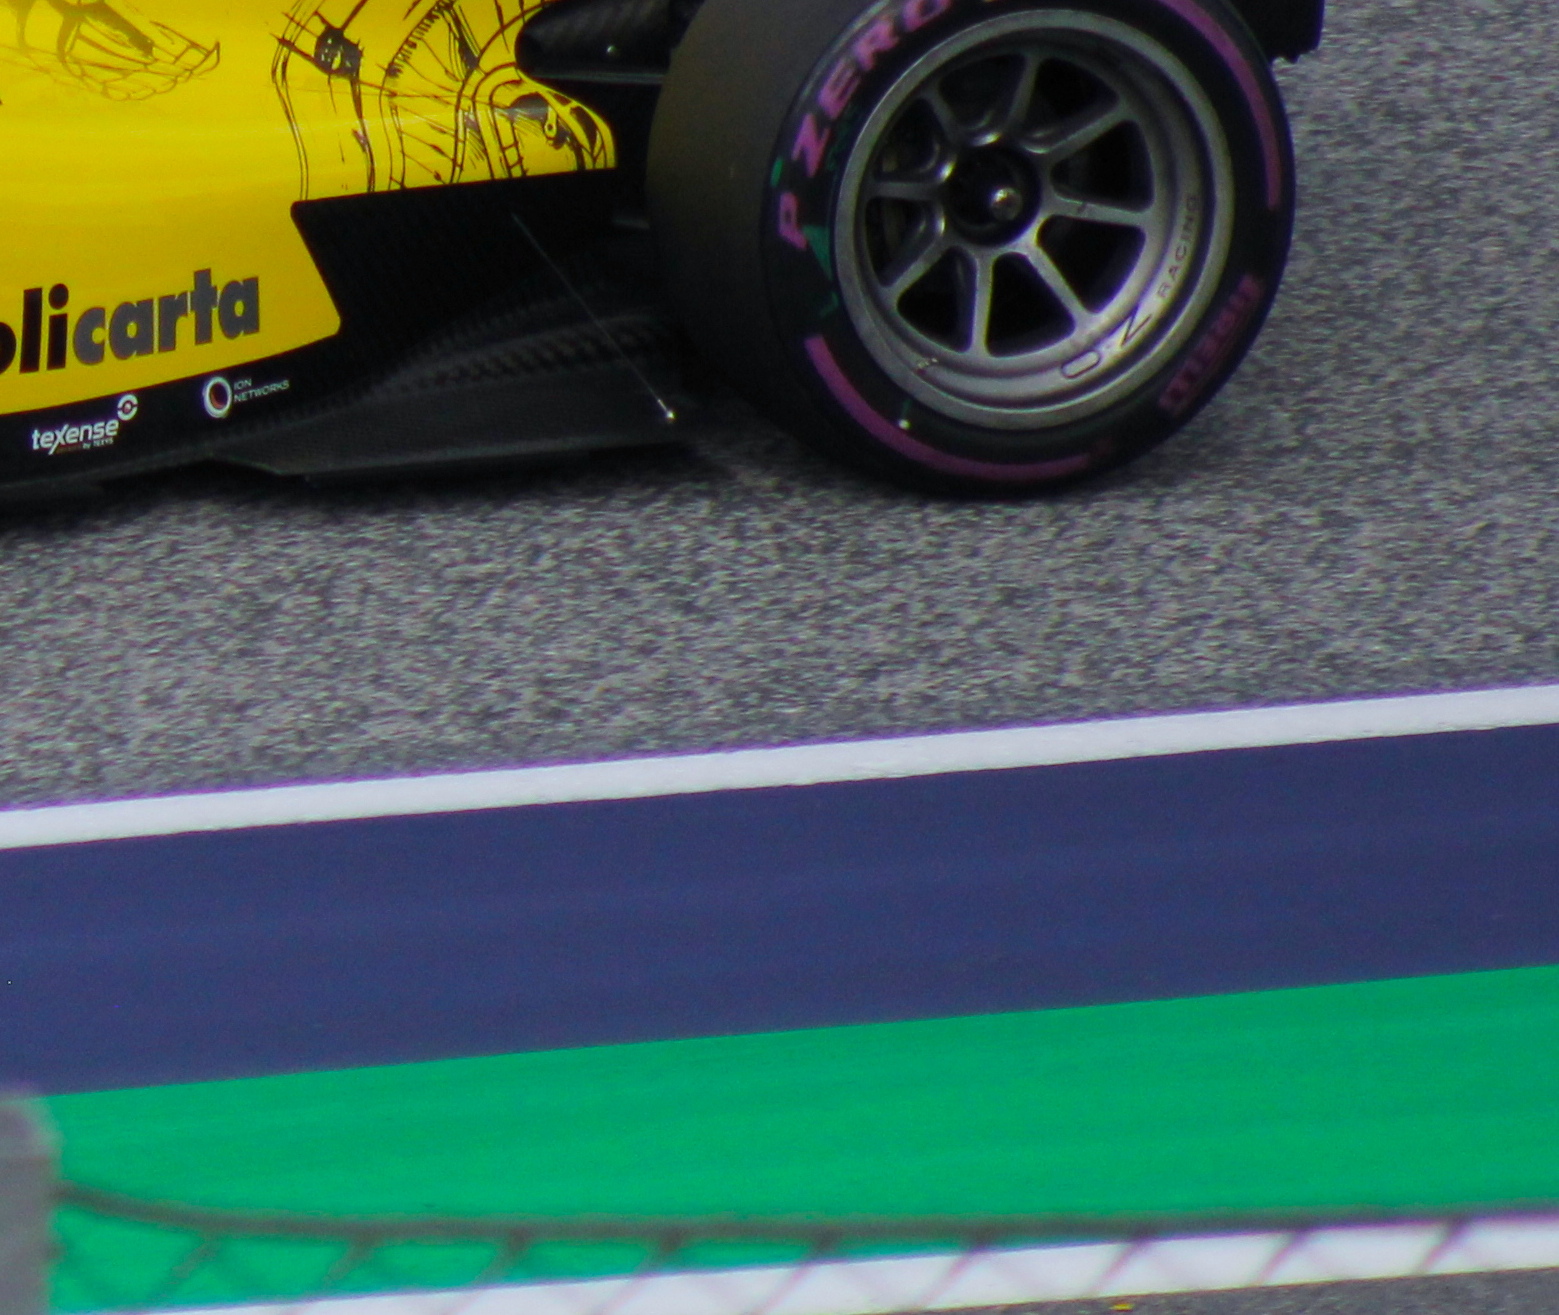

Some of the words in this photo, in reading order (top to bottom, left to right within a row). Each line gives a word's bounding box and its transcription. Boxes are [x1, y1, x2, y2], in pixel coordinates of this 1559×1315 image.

[777, 191, 808, 250] P
[234, 378, 252, 390] ION
[234, 380, 290, 403] NETWORKS
[32, 418, 119, 455] texense
